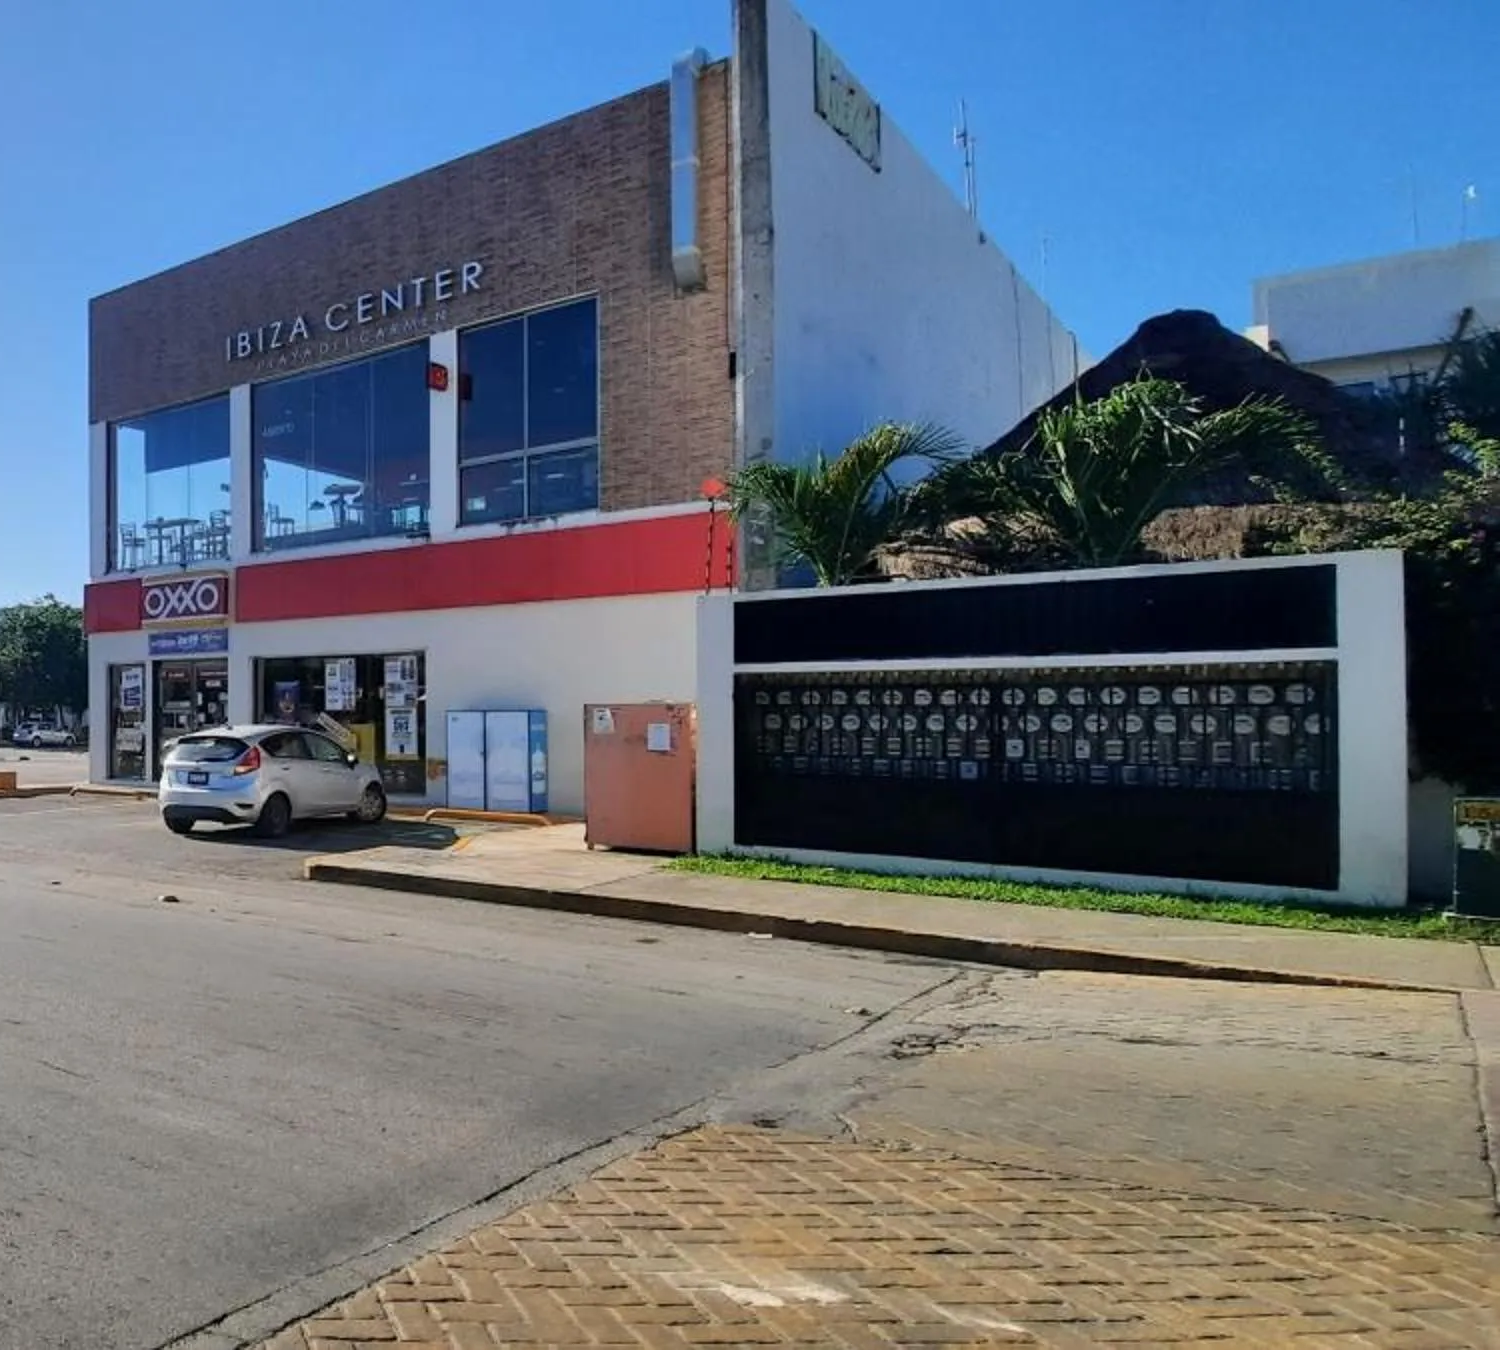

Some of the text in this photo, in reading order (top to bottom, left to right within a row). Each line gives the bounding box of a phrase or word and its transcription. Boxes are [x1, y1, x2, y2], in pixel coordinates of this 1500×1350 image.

[226, 262, 483, 361] IBIZA CENTER
[360, 311, 448, 343] CARMEN
[144, 579, 219, 617] OXXO
